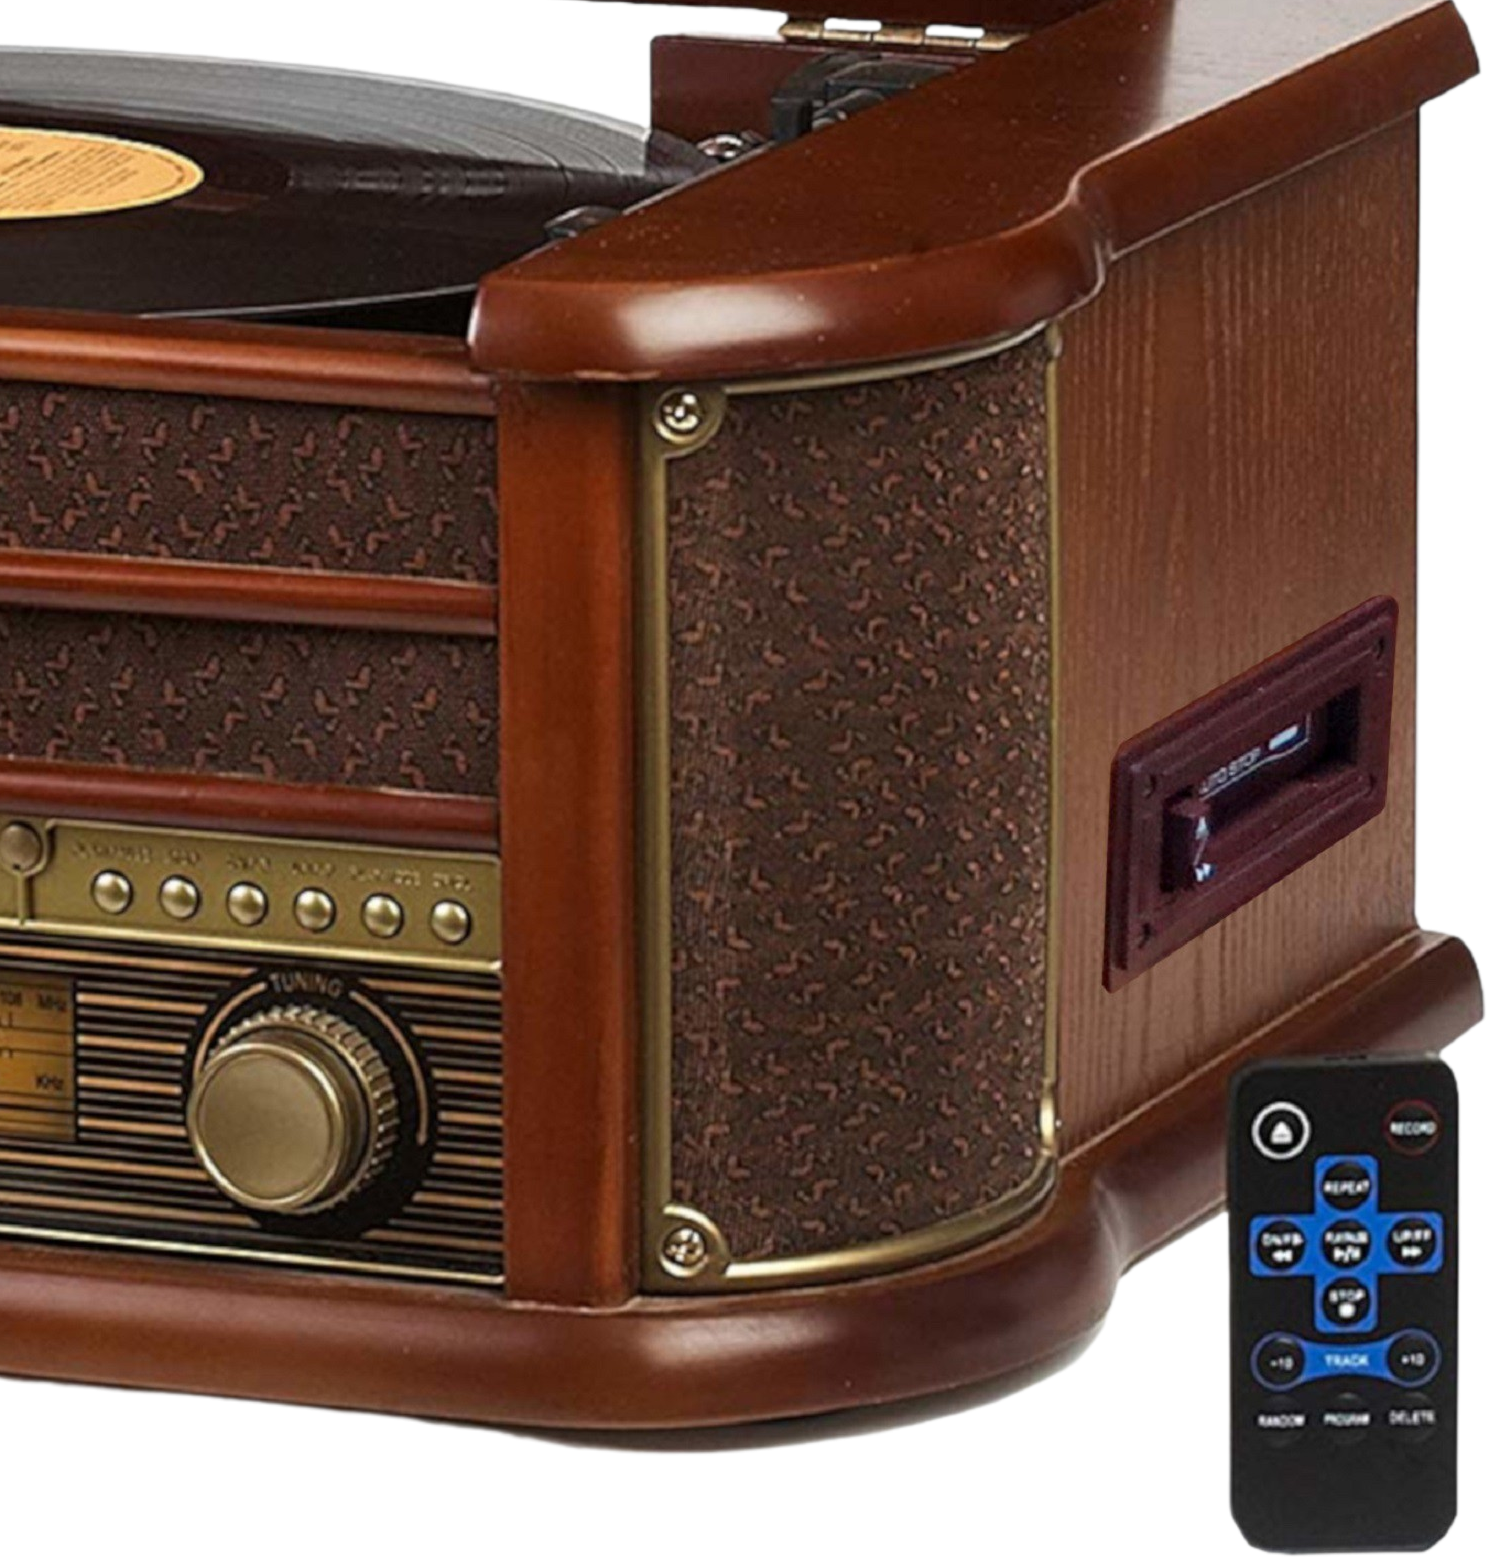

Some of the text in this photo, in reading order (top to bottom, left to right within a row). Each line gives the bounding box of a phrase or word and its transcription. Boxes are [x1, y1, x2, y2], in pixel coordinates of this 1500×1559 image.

[268, 971, 344, 998] TUNING
[1390, 1121, 1438, 1136] RECORD
[1323, 1179, 1371, 1196] REPEAT
[1328, 1288, 1366, 1304] STOP
[1323, 1353, 1369, 1368] TRACK
[1257, 1413, 1306, 1428] RANDOM
[1389, 1409, 1437, 1426] DELETE
